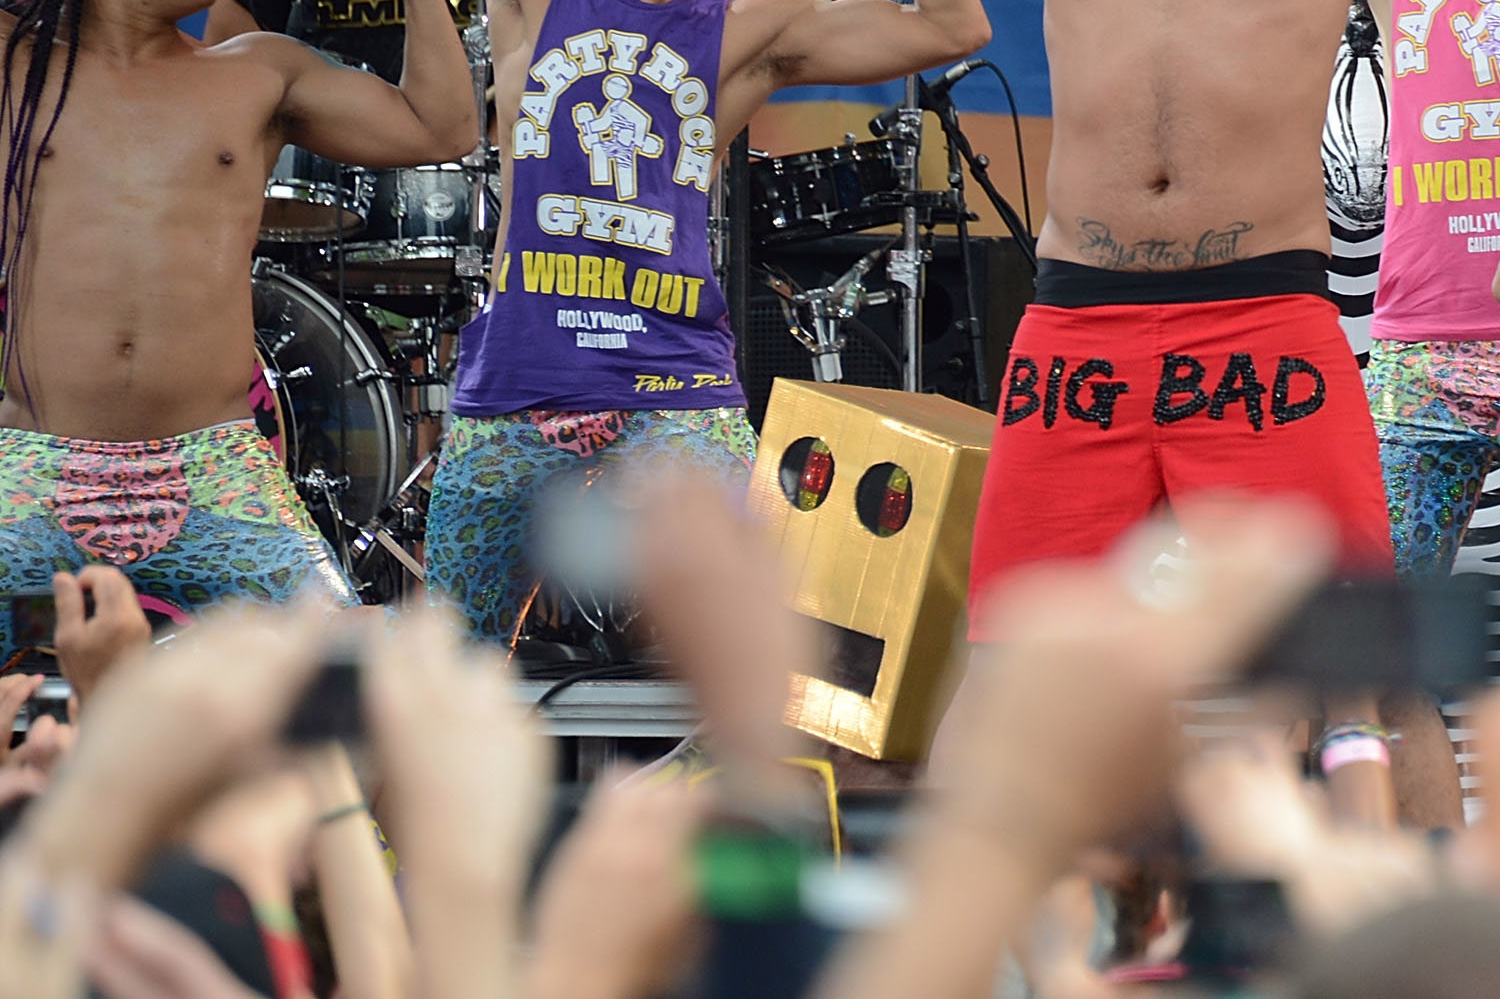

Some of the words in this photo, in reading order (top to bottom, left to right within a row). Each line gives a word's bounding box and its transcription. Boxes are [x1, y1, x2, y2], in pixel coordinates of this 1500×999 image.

[512, 29, 648, 160] PARTY
[639, 42, 716, 193] ROCK
[1393, 166, 1404, 207] I
[536, 193, 676, 256] GYM
[521, 251, 627, 301] WORK
[630, 268, 706, 318] OUT
[557, 309, 648, 333] HOLLYWOOD,
[1002, 356, 1131, 431] BIG
[1153, 352, 1326, 432] BAD
